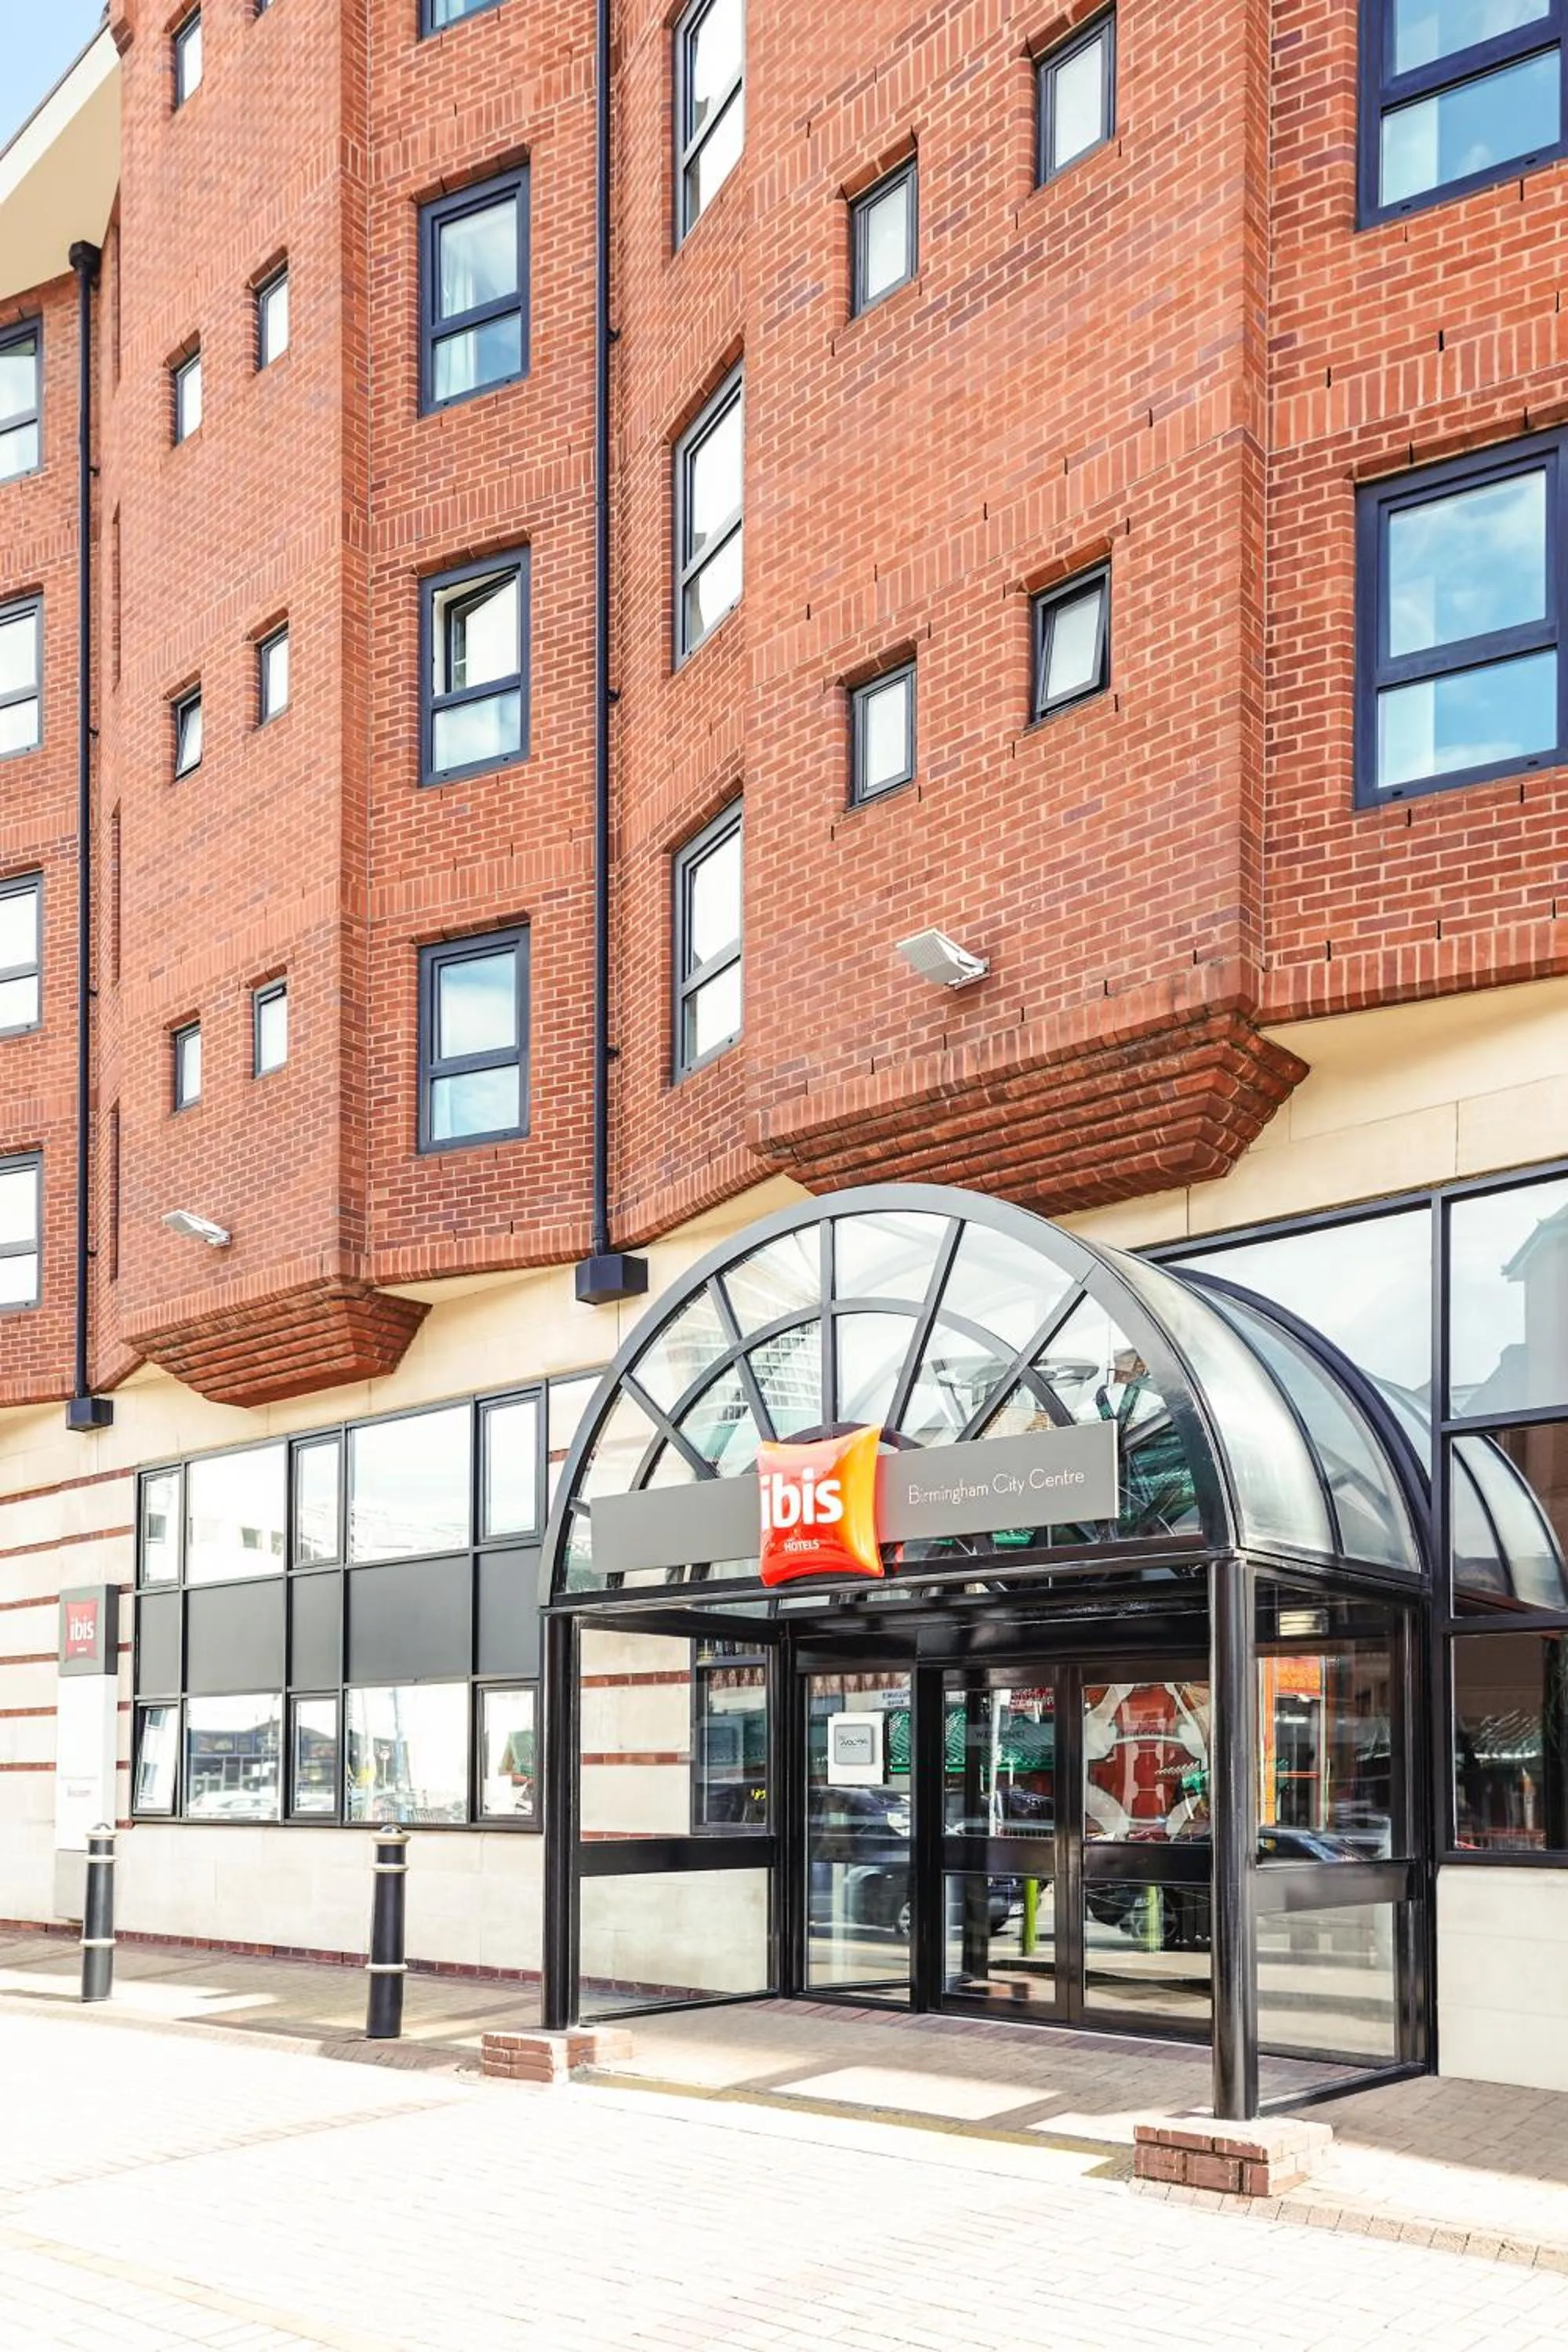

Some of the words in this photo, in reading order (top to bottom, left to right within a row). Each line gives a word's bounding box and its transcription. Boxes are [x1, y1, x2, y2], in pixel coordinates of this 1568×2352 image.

[760, 1468, 844, 1530] ibis
[908, 1479, 989, 1504] Birmingham
[992, 1473, 1025, 1496] City
[1029, 1468, 1085, 1489] Centre
[785, 1539, 819, 1552] HOTELS
[70, 1616, 94, 1641] ibis
